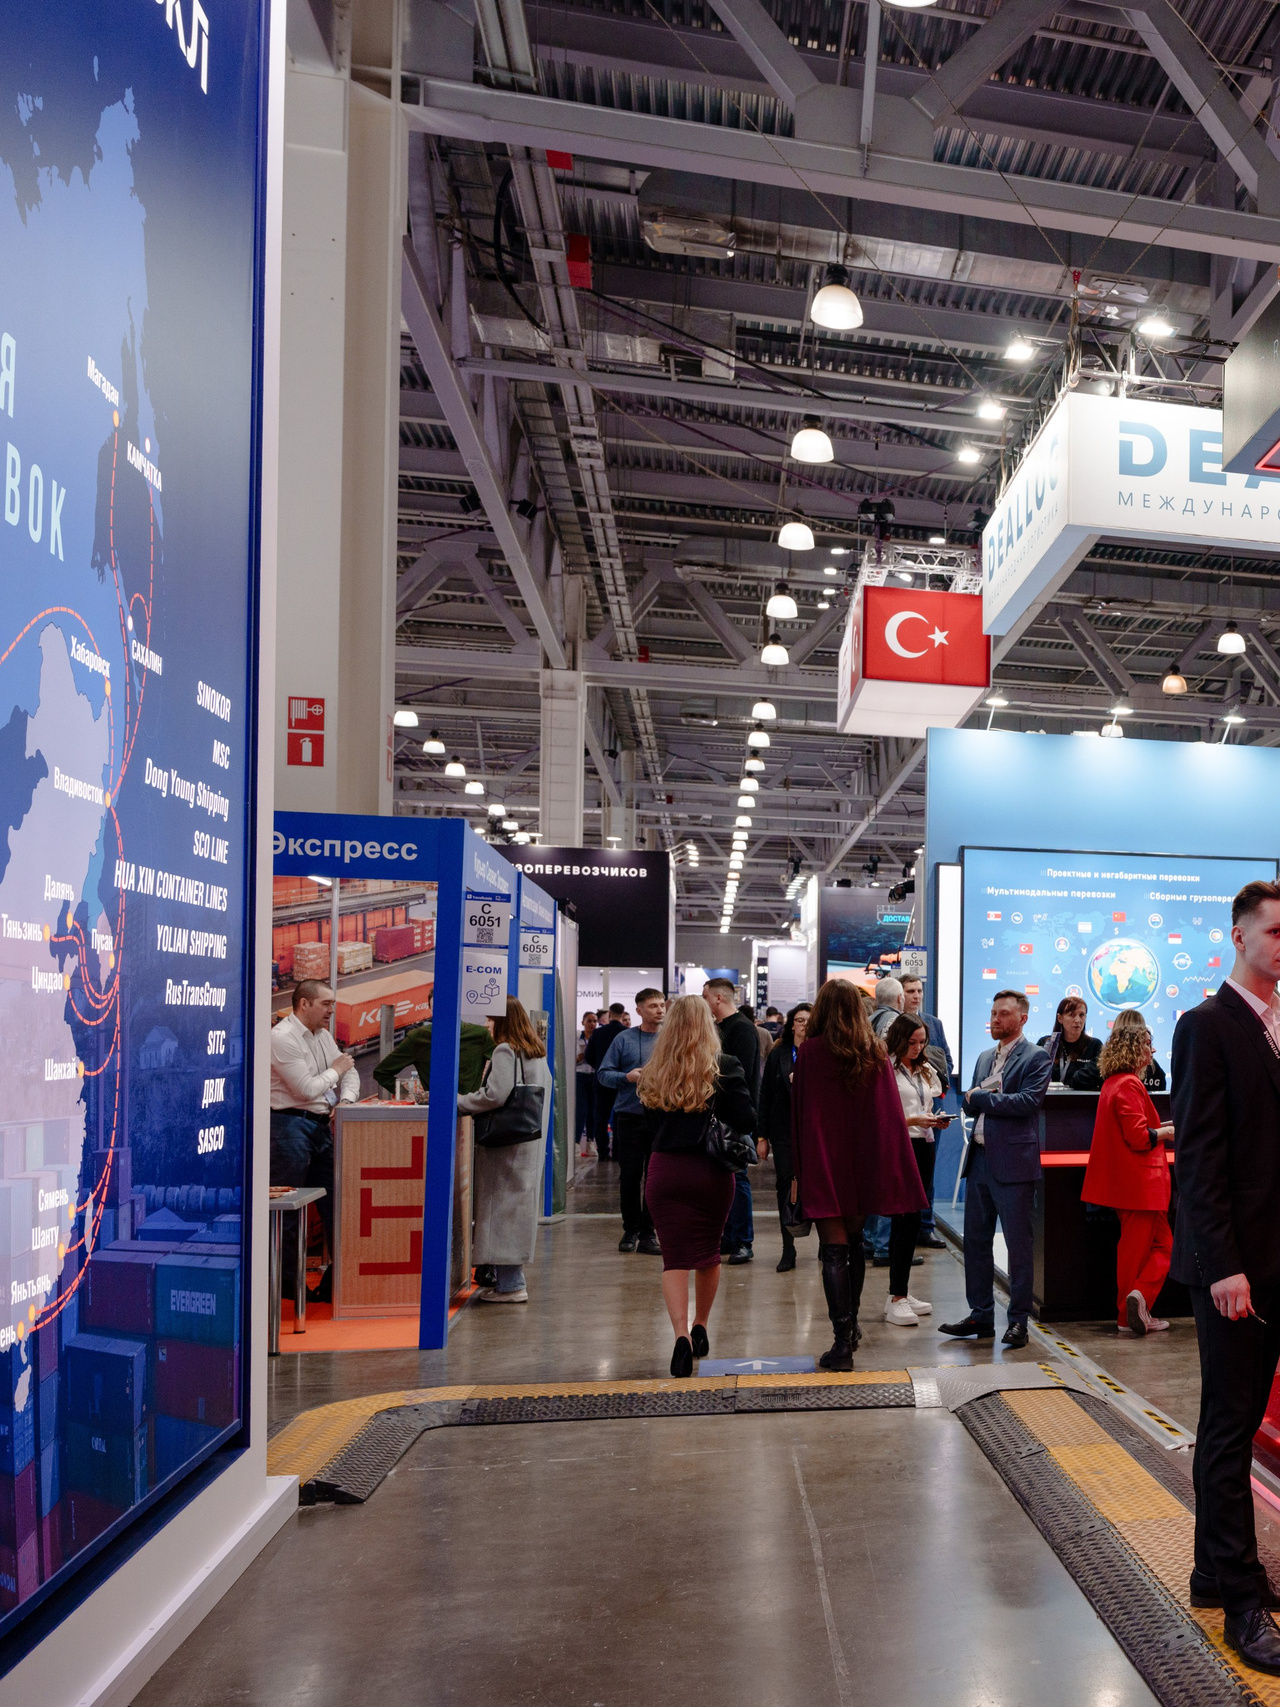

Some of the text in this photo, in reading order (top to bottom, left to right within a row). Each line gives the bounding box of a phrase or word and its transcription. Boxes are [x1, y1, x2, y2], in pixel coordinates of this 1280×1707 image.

[87, 355, 119, 407] Магадан
[126, 440, 162, 492] КАМЧАТКА
[71, 635, 111, 678] Хабаровск
[131, 639, 163, 676] САХАЛИН
[197, 680, 231, 723] SINOKOR
[212, 739, 230, 770] MSC
[54, 766, 104, 806] Владивосток
[145, 757, 230, 822] Dong Young Shipping
[193, 830, 229, 864] SCO LINE
[273, 831, 419, 864] Экспресс
[114, 859, 228, 912] HUA XIN CONTAINER LINES
[512, 863, 648, 878] ЗОПЕРЕВОЗЧИКОВ
[1047, 868, 1092, 880] Проектные
[1101, 870, 1157, 882] негабаритные
[1159, 873, 1201, 883] перевозки
[44, 874, 75, 901] Далянь
[987, 886, 1116, 900] Мультимодальные перевозки
[1149, 891, 1187, 902] Сборные
[2, 913, 43, 942] Тяньзинь
[469, 915, 501, 928] 6051
[91, 928, 114, 952] Пусан
[157, 924, 227, 959] YOLIAN SHIPPING
[522, 944, 548, 954] 6055
[32, 966, 63, 993] Циндао
[466, 965, 502, 975] E-COM
[165, 978, 227, 1012] RusTransGroup
[207, 1029, 226, 1055] SITC
[44, 1057, 76, 1081] Шанхай
[202, 1077, 226, 1109] ДВЛК
[197, 1124, 225, 1155] SASCO
[38, 1188, 69, 1213] Сямень
[358, 1135, 425, 1276] LTL
[32, 1225, 59, 1250] Шанту
[11, 1272, 51, 1305] Яньтьянь
[170, 1289, 217, 1316] EVERGREEN
